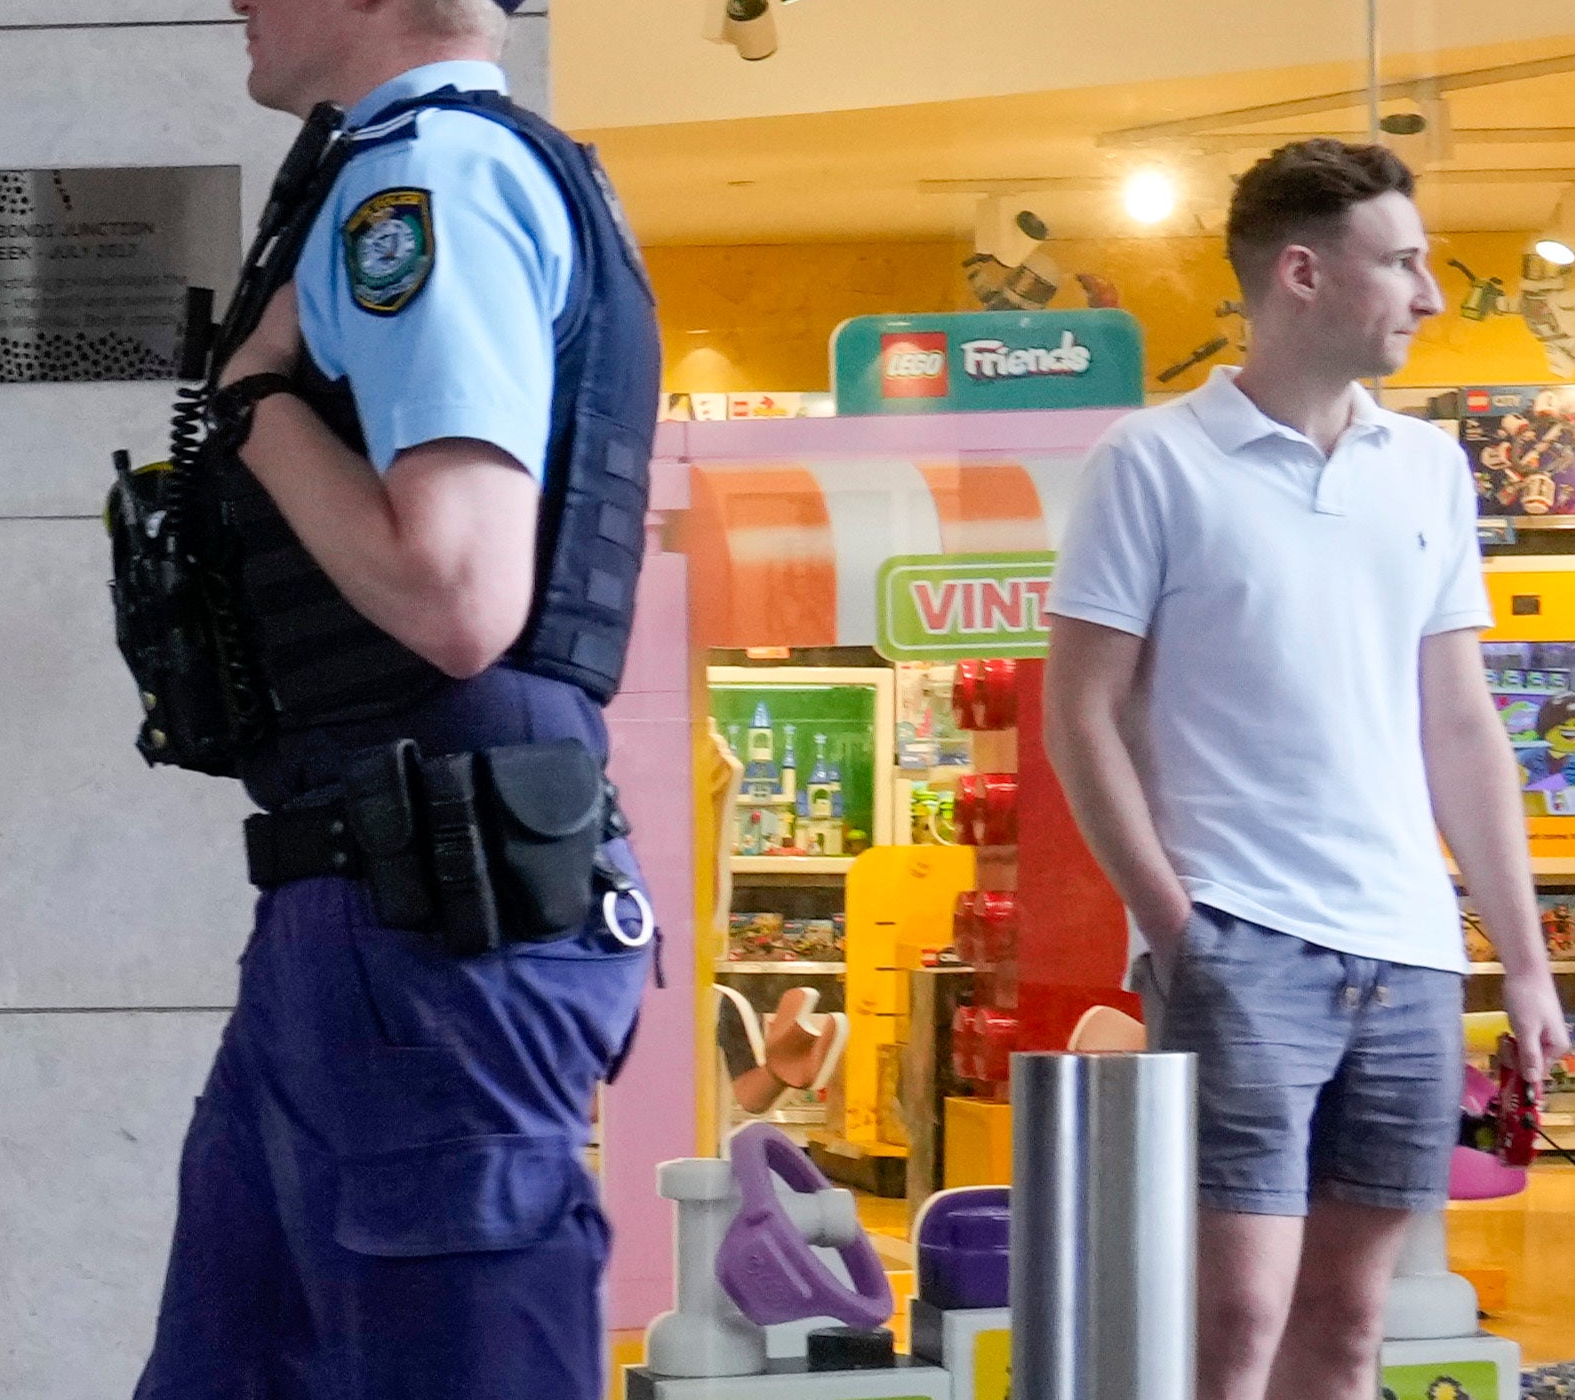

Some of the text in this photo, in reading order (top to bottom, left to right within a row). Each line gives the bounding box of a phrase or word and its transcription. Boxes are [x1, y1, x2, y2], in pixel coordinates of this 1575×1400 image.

[61, 221, 156, 238] JUNCTION
[886, 330, 1091, 377] LEGO Friends
